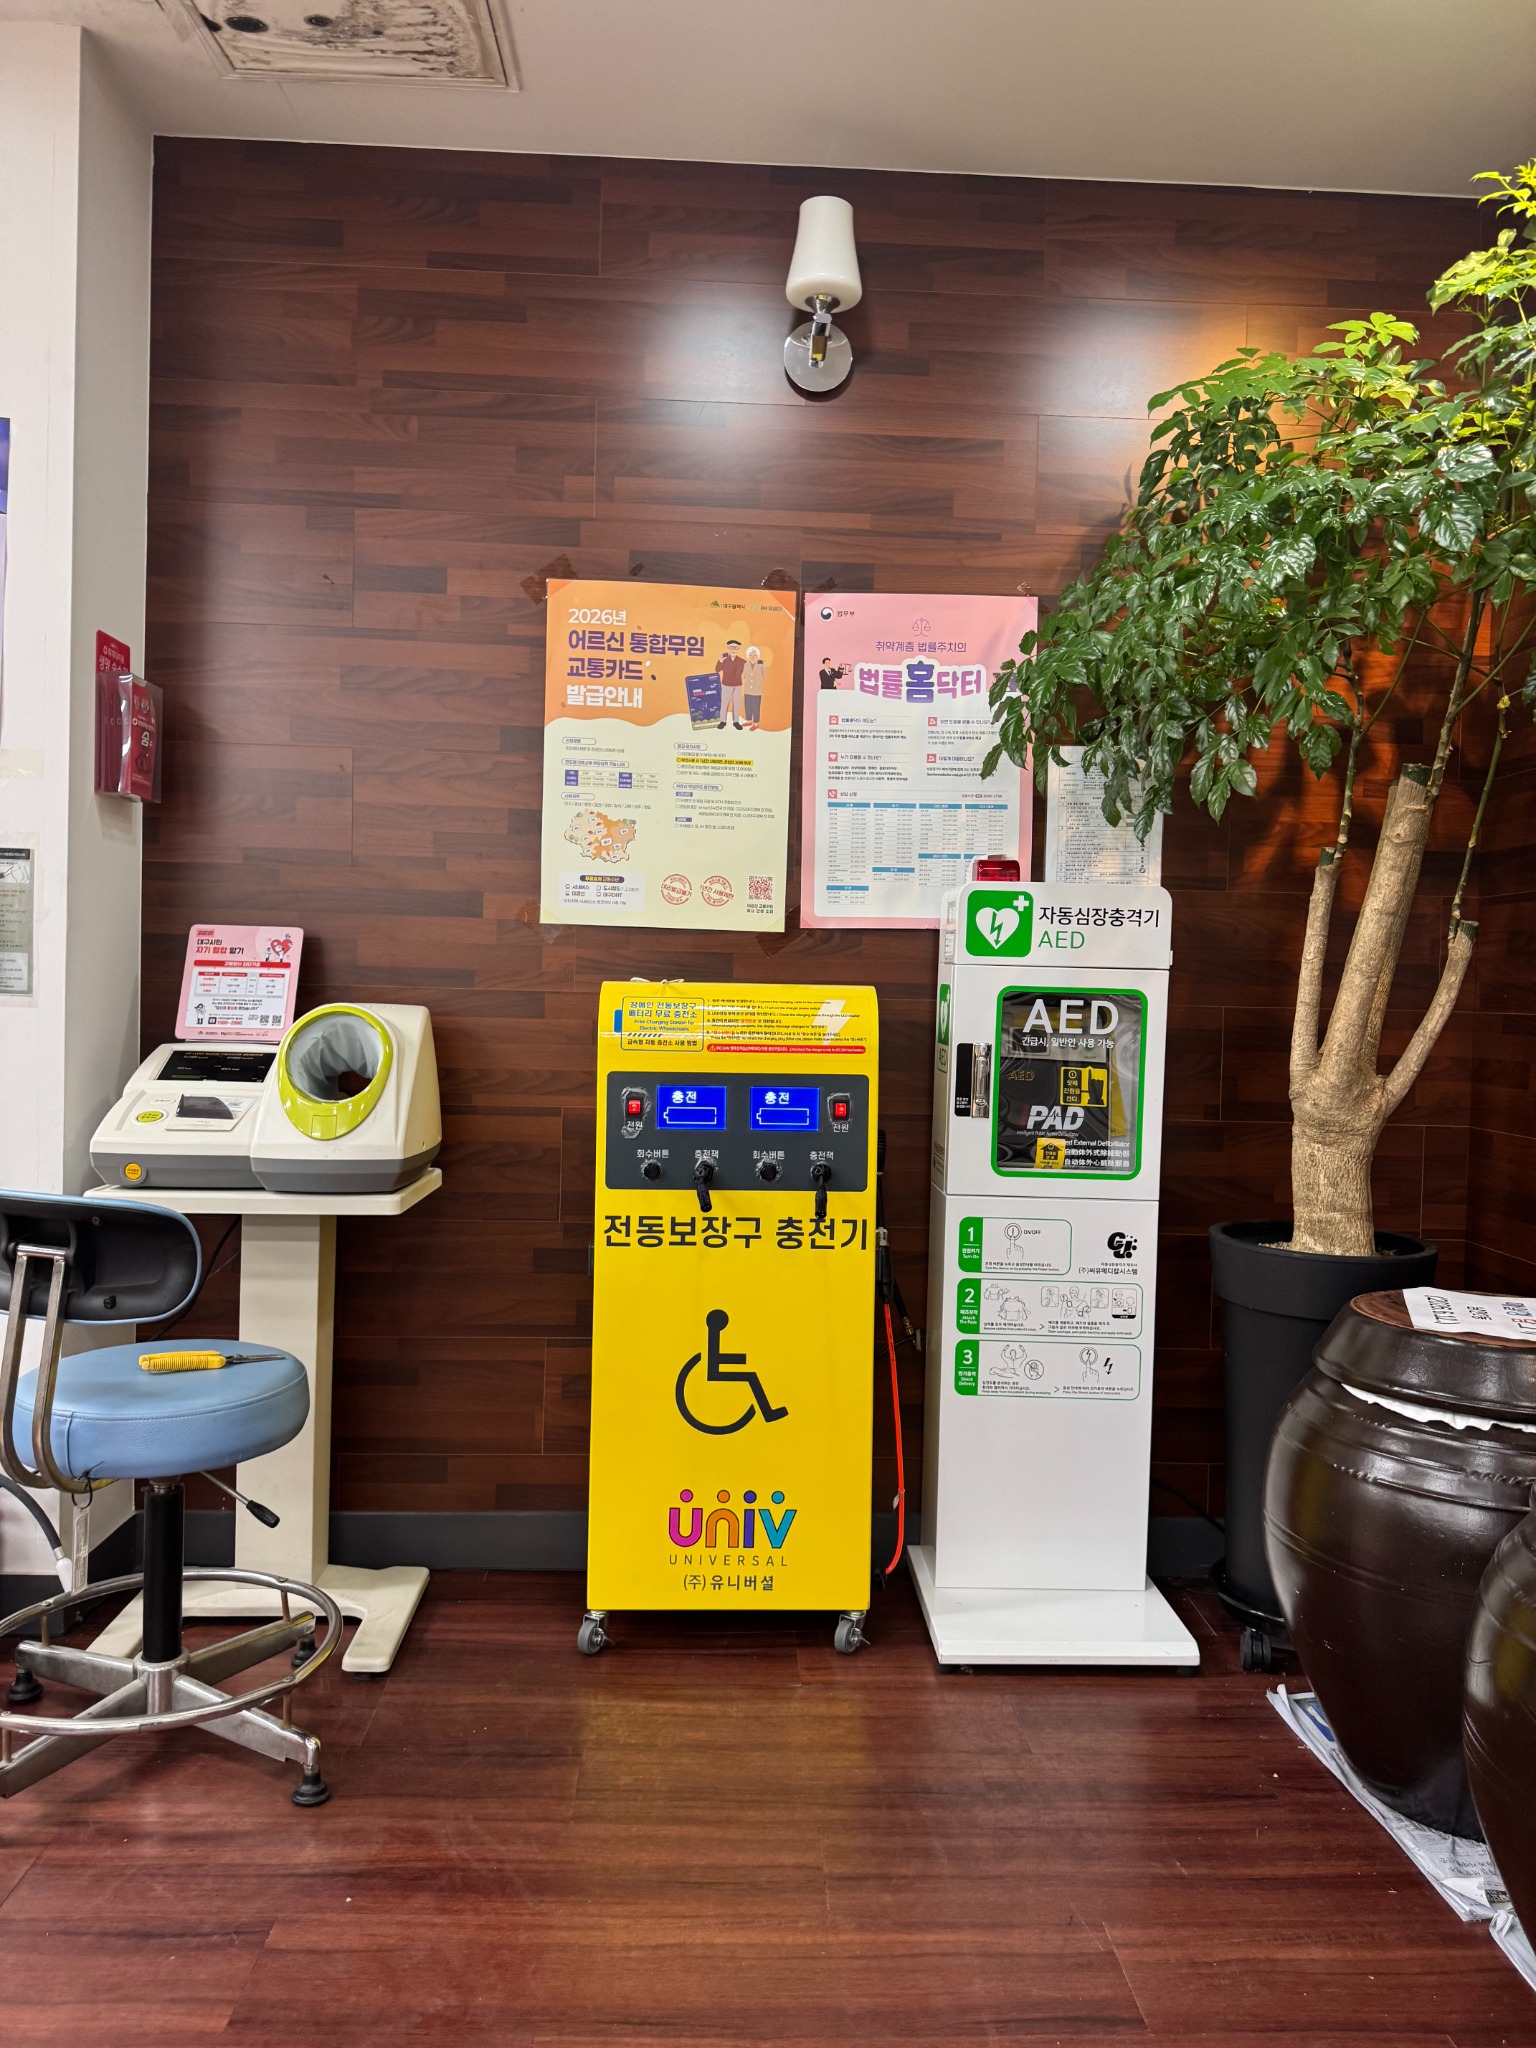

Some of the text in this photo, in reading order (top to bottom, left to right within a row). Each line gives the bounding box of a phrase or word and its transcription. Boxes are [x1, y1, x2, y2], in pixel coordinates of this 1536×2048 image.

[568, 608, 626, 625] 2026년
[568, 630, 705, 656] 어르신 통합무임
[875, 640, 966, 653] 취약계층 법률주치의
[567, 658, 643, 680] 교통카드
[859, 661, 981, 703] 법률홈닥터
[566, 685, 643, 708] 발급안내
[1039, 906, 1159, 928] 자동심장충격기
[1038, 930, 1085, 949] AED
[1023, 999, 1119, 1035] AED
[1022, 1036, 1114, 1049] 긴급시, 일반인 사용 가능
[1008, 1070, 1034, 1081] AED
[671, 1090, 698, 1104] 충전
[764, 1091, 790, 1105] 충전
[627, 1121, 643, 1131] 전원
[833, 1123, 849, 1133] 전원
[637, 1148, 670, 1159] 회수버튼
[694, 1149, 719, 1160] 충전잭
[752, 1150, 785, 1160] 회수버튼
[809, 1151, 834, 1161] 충전잭
[603, 1215, 868, 1250] 전동보장구 충전기
[967, 1227, 974, 1241] 1
[964, 1288, 974, 1303] 2
[963, 1350, 973, 1364] 3
[669, 1554, 787, 1566] UNIVERSAL
